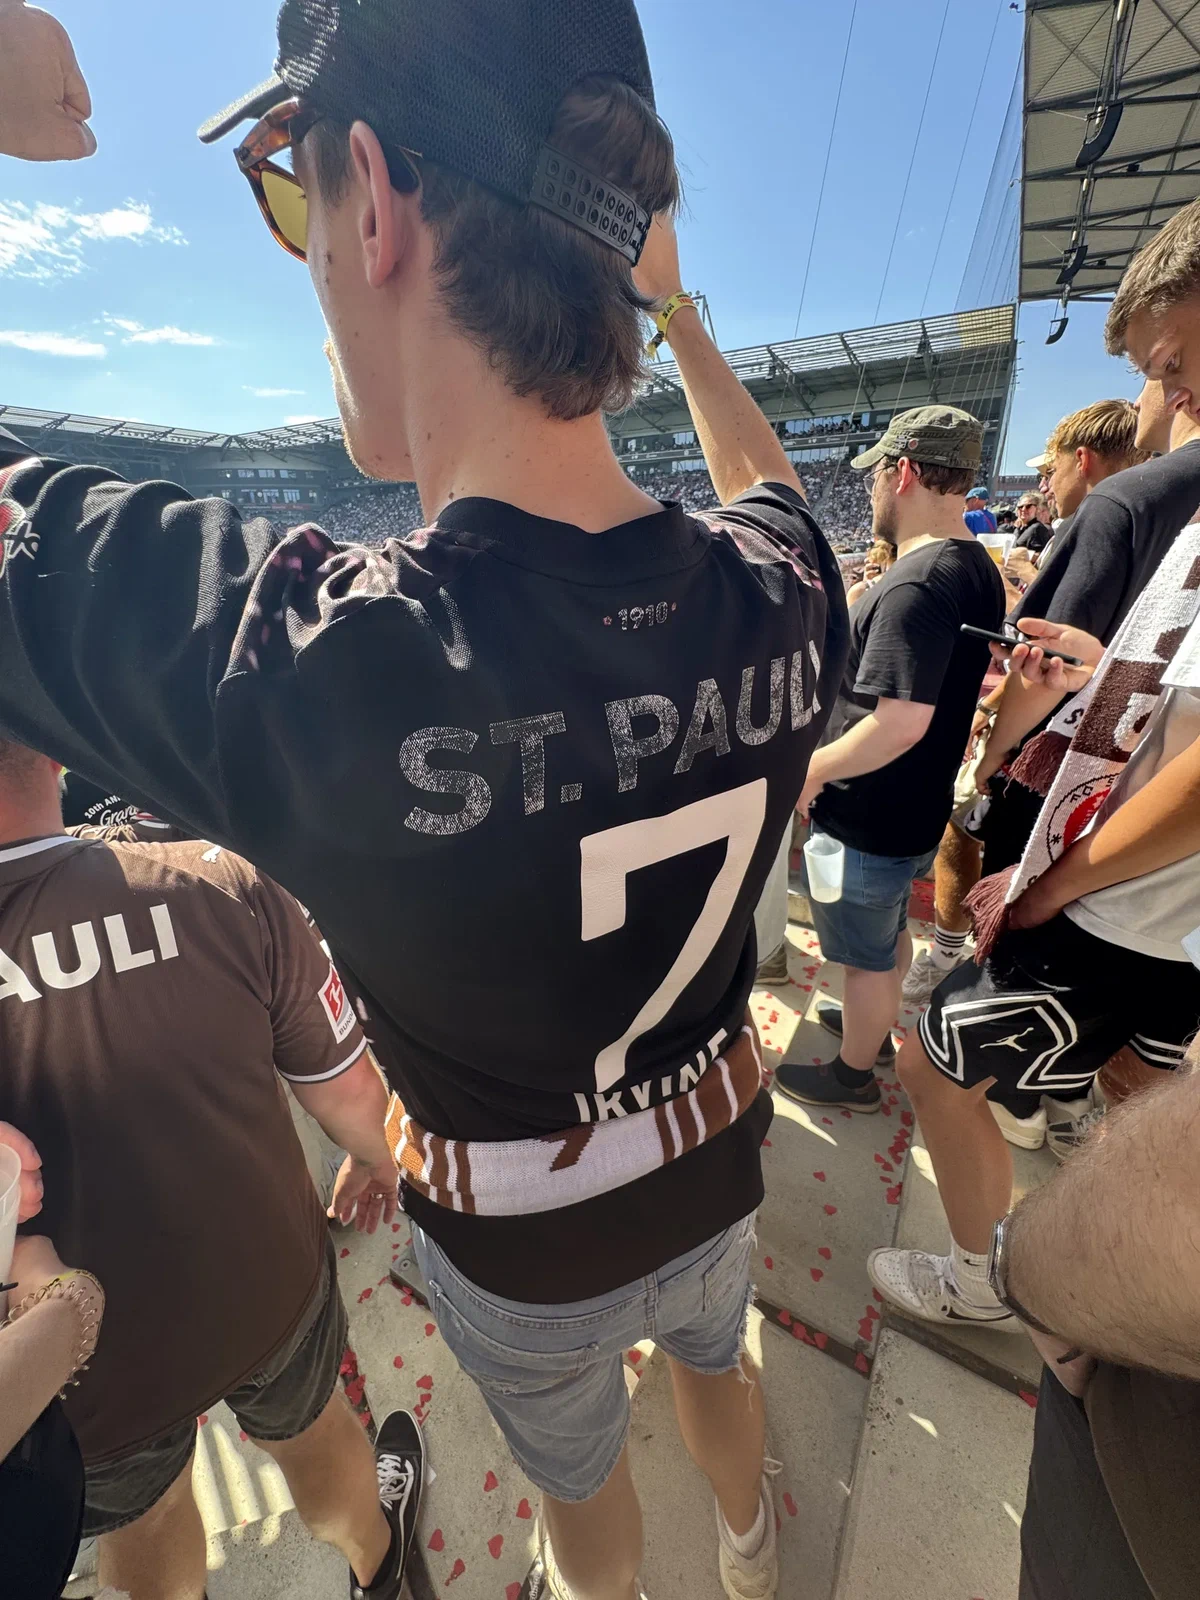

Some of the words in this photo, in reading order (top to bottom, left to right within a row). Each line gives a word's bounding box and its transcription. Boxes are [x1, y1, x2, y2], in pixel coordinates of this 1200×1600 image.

[617, 601, 669, 631] 1910
[399, 710, 583, 836] ST.
[604, 640, 821, 793] PAULI
[84, 802, 105, 819] 10th
[579, 777, 768, 1093] 7
